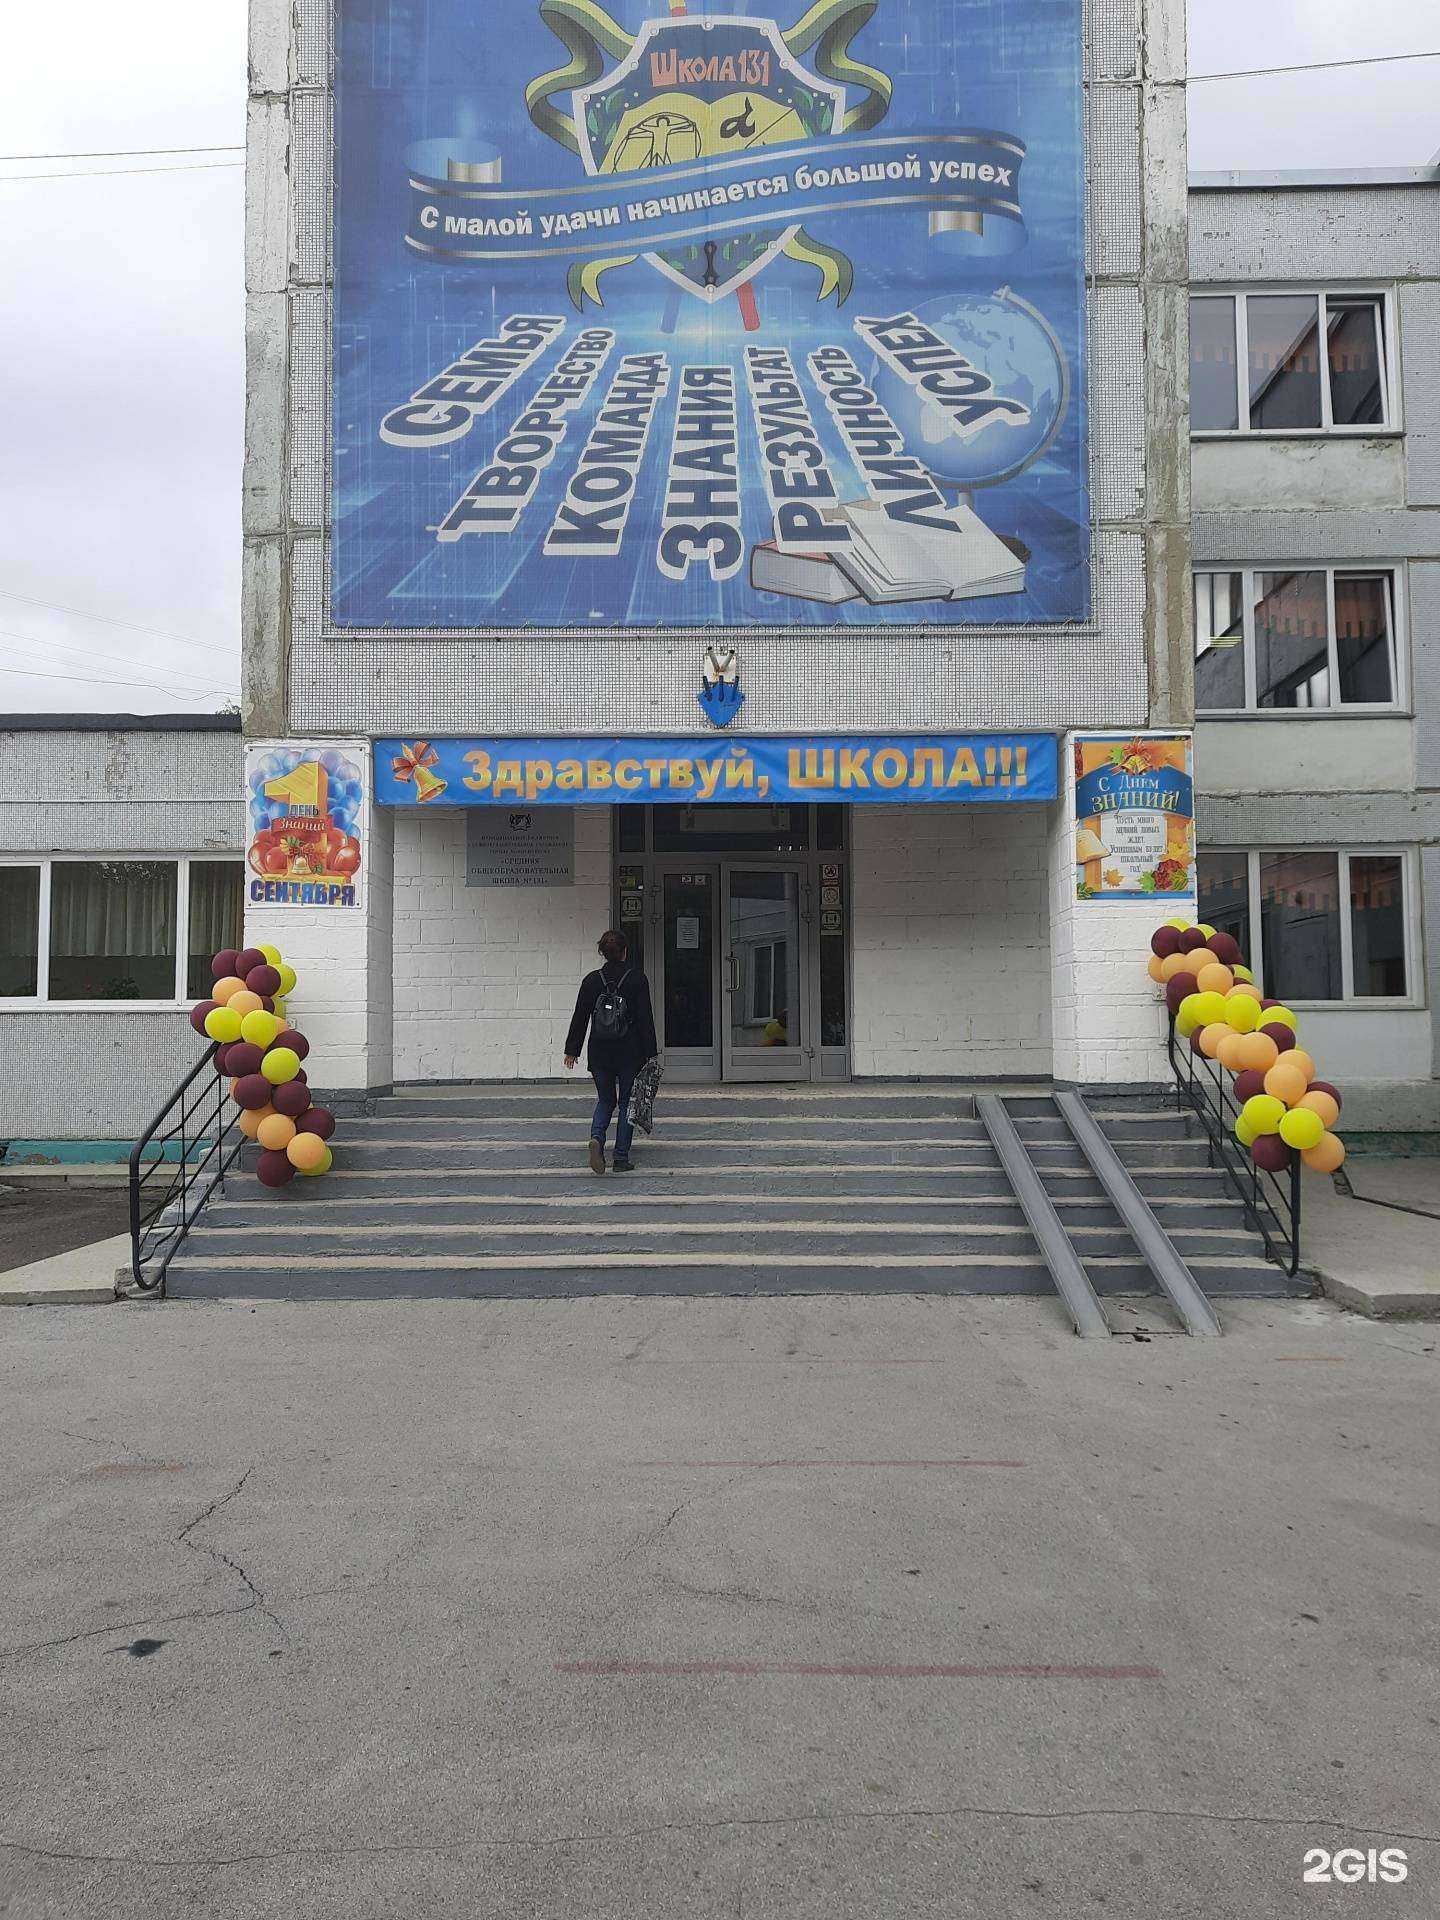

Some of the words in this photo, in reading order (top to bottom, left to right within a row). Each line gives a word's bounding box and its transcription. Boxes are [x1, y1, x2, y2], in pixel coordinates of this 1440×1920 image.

[420, 205, 440, 229] С
[444, 209, 533, 237] малой
[539, 204, 621, 239] удачи
[627, 174, 789, 222] начинается
[794, 153, 922, 191] большой
[928, 159, 1013, 188] успех
[381, 315, 565, 442] СЕМЬЯ
[438, 328, 614, 538] ТВОРЧЕСТВО
[856, 313, 1029, 432] УСПЕХ
[545, 352, 669, 554] КОМАНДА
[657, 366, 743, 579] ЗНАНИЯ
[745, 346, 855, 548] РЕЗУЛЬТАТ
[809, 347, 963, 534] ЛИЧНОСТЬ
[289, 803, 319, 818] ДЕНЬ
[462, 749, 770, 800] Здравствуй,
[788, 747, 1028, 788] ШКОЛА!!!
[250, 878, 356, 906] СЕНТЯБРЯ
